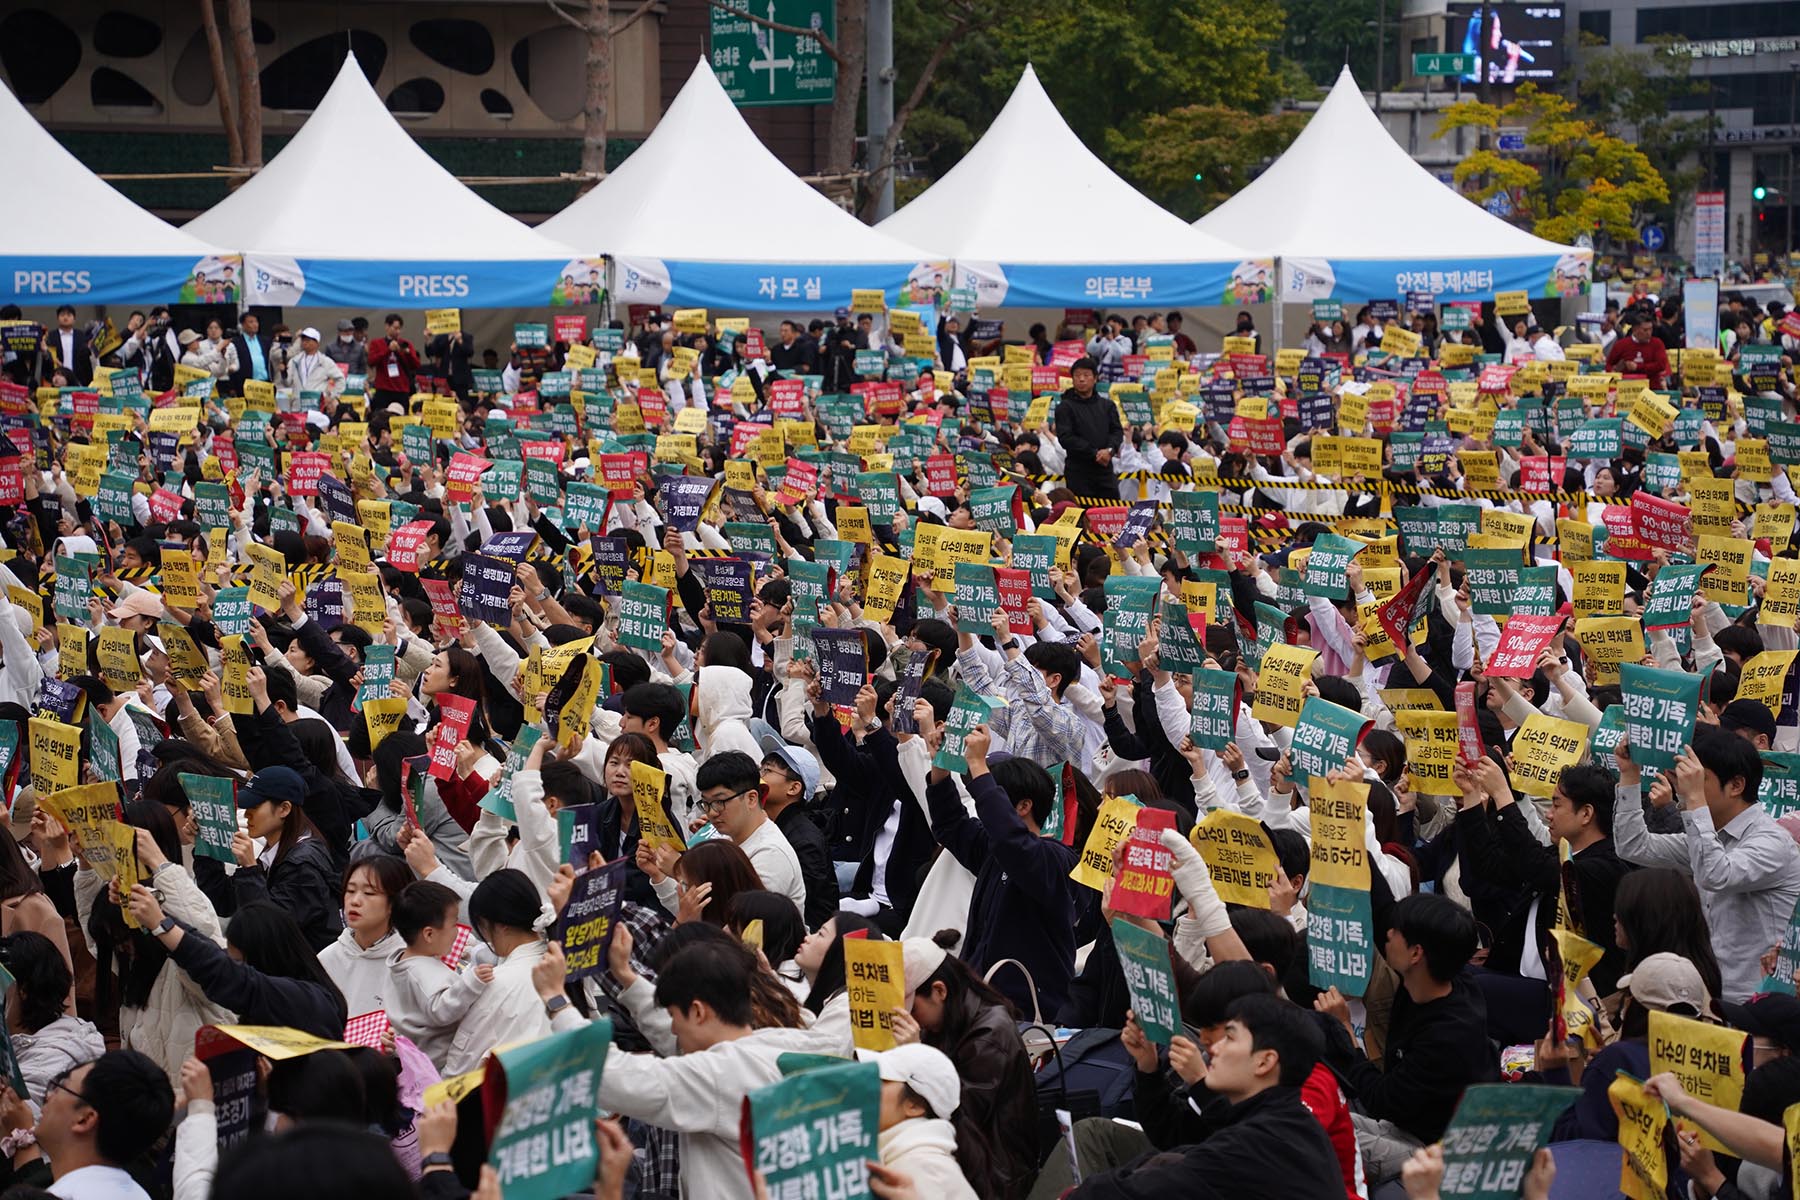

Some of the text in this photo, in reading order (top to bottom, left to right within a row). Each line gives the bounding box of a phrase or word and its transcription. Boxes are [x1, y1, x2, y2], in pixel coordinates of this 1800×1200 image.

[14, 271, 91, 293] PRESS
[399, 275, 469, 297] PRESS
[759, 277, 821, 299] 자모실
[1085, 276, 1153, 298] 의료본부
[1395, 270, 1493, 294] 안전통제센터
[1571, 429, 1620, 441] 건강한 가족,
[1571, 441, 1618, 452] 거룩한 나라
[498, 471, 519, 483] 가족,
[499, 484, 517, 495] 나라
[677, 484, 708, 494] 생명파괴
[859, 486, 898, 501] 건강한 가족,
[1695, 489, 1730, 501] 다수의 역차별
[567, 493, 592, 508] 건강한
[971, 499, 1010, 518] 건강한 가족,
[672, 506, 700, 517] 가정파괴
[1174, 508, 1216, 525] 건강한 가족,
[996, 517, 1011, 530] 나라
[1401, 521, 1425, 534] 건강한
[1439, 521, 1460, 535] 건강한
[1485, 517, 1525, 535] 다수의 역차별
[1176, 526, 1215, 542] 거룩한 나라
[730, 536, 774, 552] 건강한 가족,
[940, 540, 984, 556] 다수의 역차별
[1369, 544, 1392, 556] 역차별
[1013, 552, 1050, 570] 건강한 가족,
[1308, 551, 1330, 567] 건강한
[1700, 548, 1745, 565] 다수의 역차별
[482, 567, 512, 584] 생명파괴
[1035, 571, 1050, 588] 나라
[1306, 571, 1347, 590] 거룩한 나라
[1467, 569, 1496, 585] 건강한
[1578, 572, 1620, 585] 다수의 역차별
[1676, 574, 1696, 591] 가족,
[1772, 570, 1798, 586] 다수의
[71, 578, 91, 593] 가족,
[462, 580, 476, 596] 동성
[791, 580, 809, 596] 건강한
[955, 583, 998, 604] 건강한 가족,
[1365, 579, 1393, 592] 역차별
[1536, 586, 1554, 602] 가족,
[1585, 585, 1610, 597] 조장하는
[1731, 580, 1746, 594] 반대
[480, 594, 510, 610] 가정파괴
[711, 589, 743, 603] 앞당겨지는
[1474, 589, 1502, 604] 거룩한
[1647, 595, 1692, 613] 거룩한 나라
[214, 601, 236, 617] 건강한
[620, 598, 666, 623] 건강한 가족,
[714, 605, 742, 618] 인구소멸
[1574, 599, 1622, 611] 차별금지법 반대
[1115, 610, 1133, 627] 건강한
[619, 618, 663, 641] 거룩한 나라
[1173, 624, 1194, 644] 가족,
[1580, 629, 1633, 645] 다수의 역차별
[101, 639, 118, 651] 다수의
[1113, 631, 1132, 649] 거룩한
[1180, 645, 1200, 664] 나라
[1494, 653, 1535, 668] 동성 성관계
[1595, 645, 1624, 659] 조장하는
[379, 662, 393, 681] 가족,
[1263, 656, 1305, 677] 다수의 역차별
[1757, 664, 1785, 679] 역차별
[838, 670, 862, 687] 가정파괴
[1266, 675, 1289, 690] 조장하는
[1192, 692, 1231, 716] 건강한 가족,
[1253, 690, 1301, 713] 차별금지법 반대
[1622, 693, 1690, 728] 건강한 가족,
[1190, 714, 1231, 738] 거룩한 나라
[1293, 721, 1351, 758] 건강한 가족,
[1405, 727, 1430, 743] 다수의
[1521, 728, 1580, 754] 다수의 역차별
[1655, 729, 1683, 754] 나라
[34, 733, 75, 760] 다수의 역차별
[1291, 748, 1323, 778] 거룩한
[1527, 747, 1561, 766] 조장하는
[1512, 760, 1549, 782] 차별금지법
[214, 804, 235, 828] 가족,
[1101, 813, 1127, 836] 다수의
[1197, 825, 1265, 849] 다수의 역차별
[1217, 848, 1254, 867] 조장하는
[1331, 846, 1362, 867] 다수의
[1205, 861, 1274, 888] 차별금지법 반대
[1308, 912, 1369, 948] 건강한 가족,
[1309, 944, 1368, 979] 거룩한 나라
[852, 961, 890, 984] 역차별
[1655, 1038, 1731, 1077] 다수의 역차별
[1622, 1102, 1654, 1135] 다수의
[552, 1117, 593, 1166] 나라
[757, 1109, 871, 1175] 건강한 가족,
[1497, 1122, 1542, 1153] 가족,
[1481, 1159, 1526, 1193] 나라
